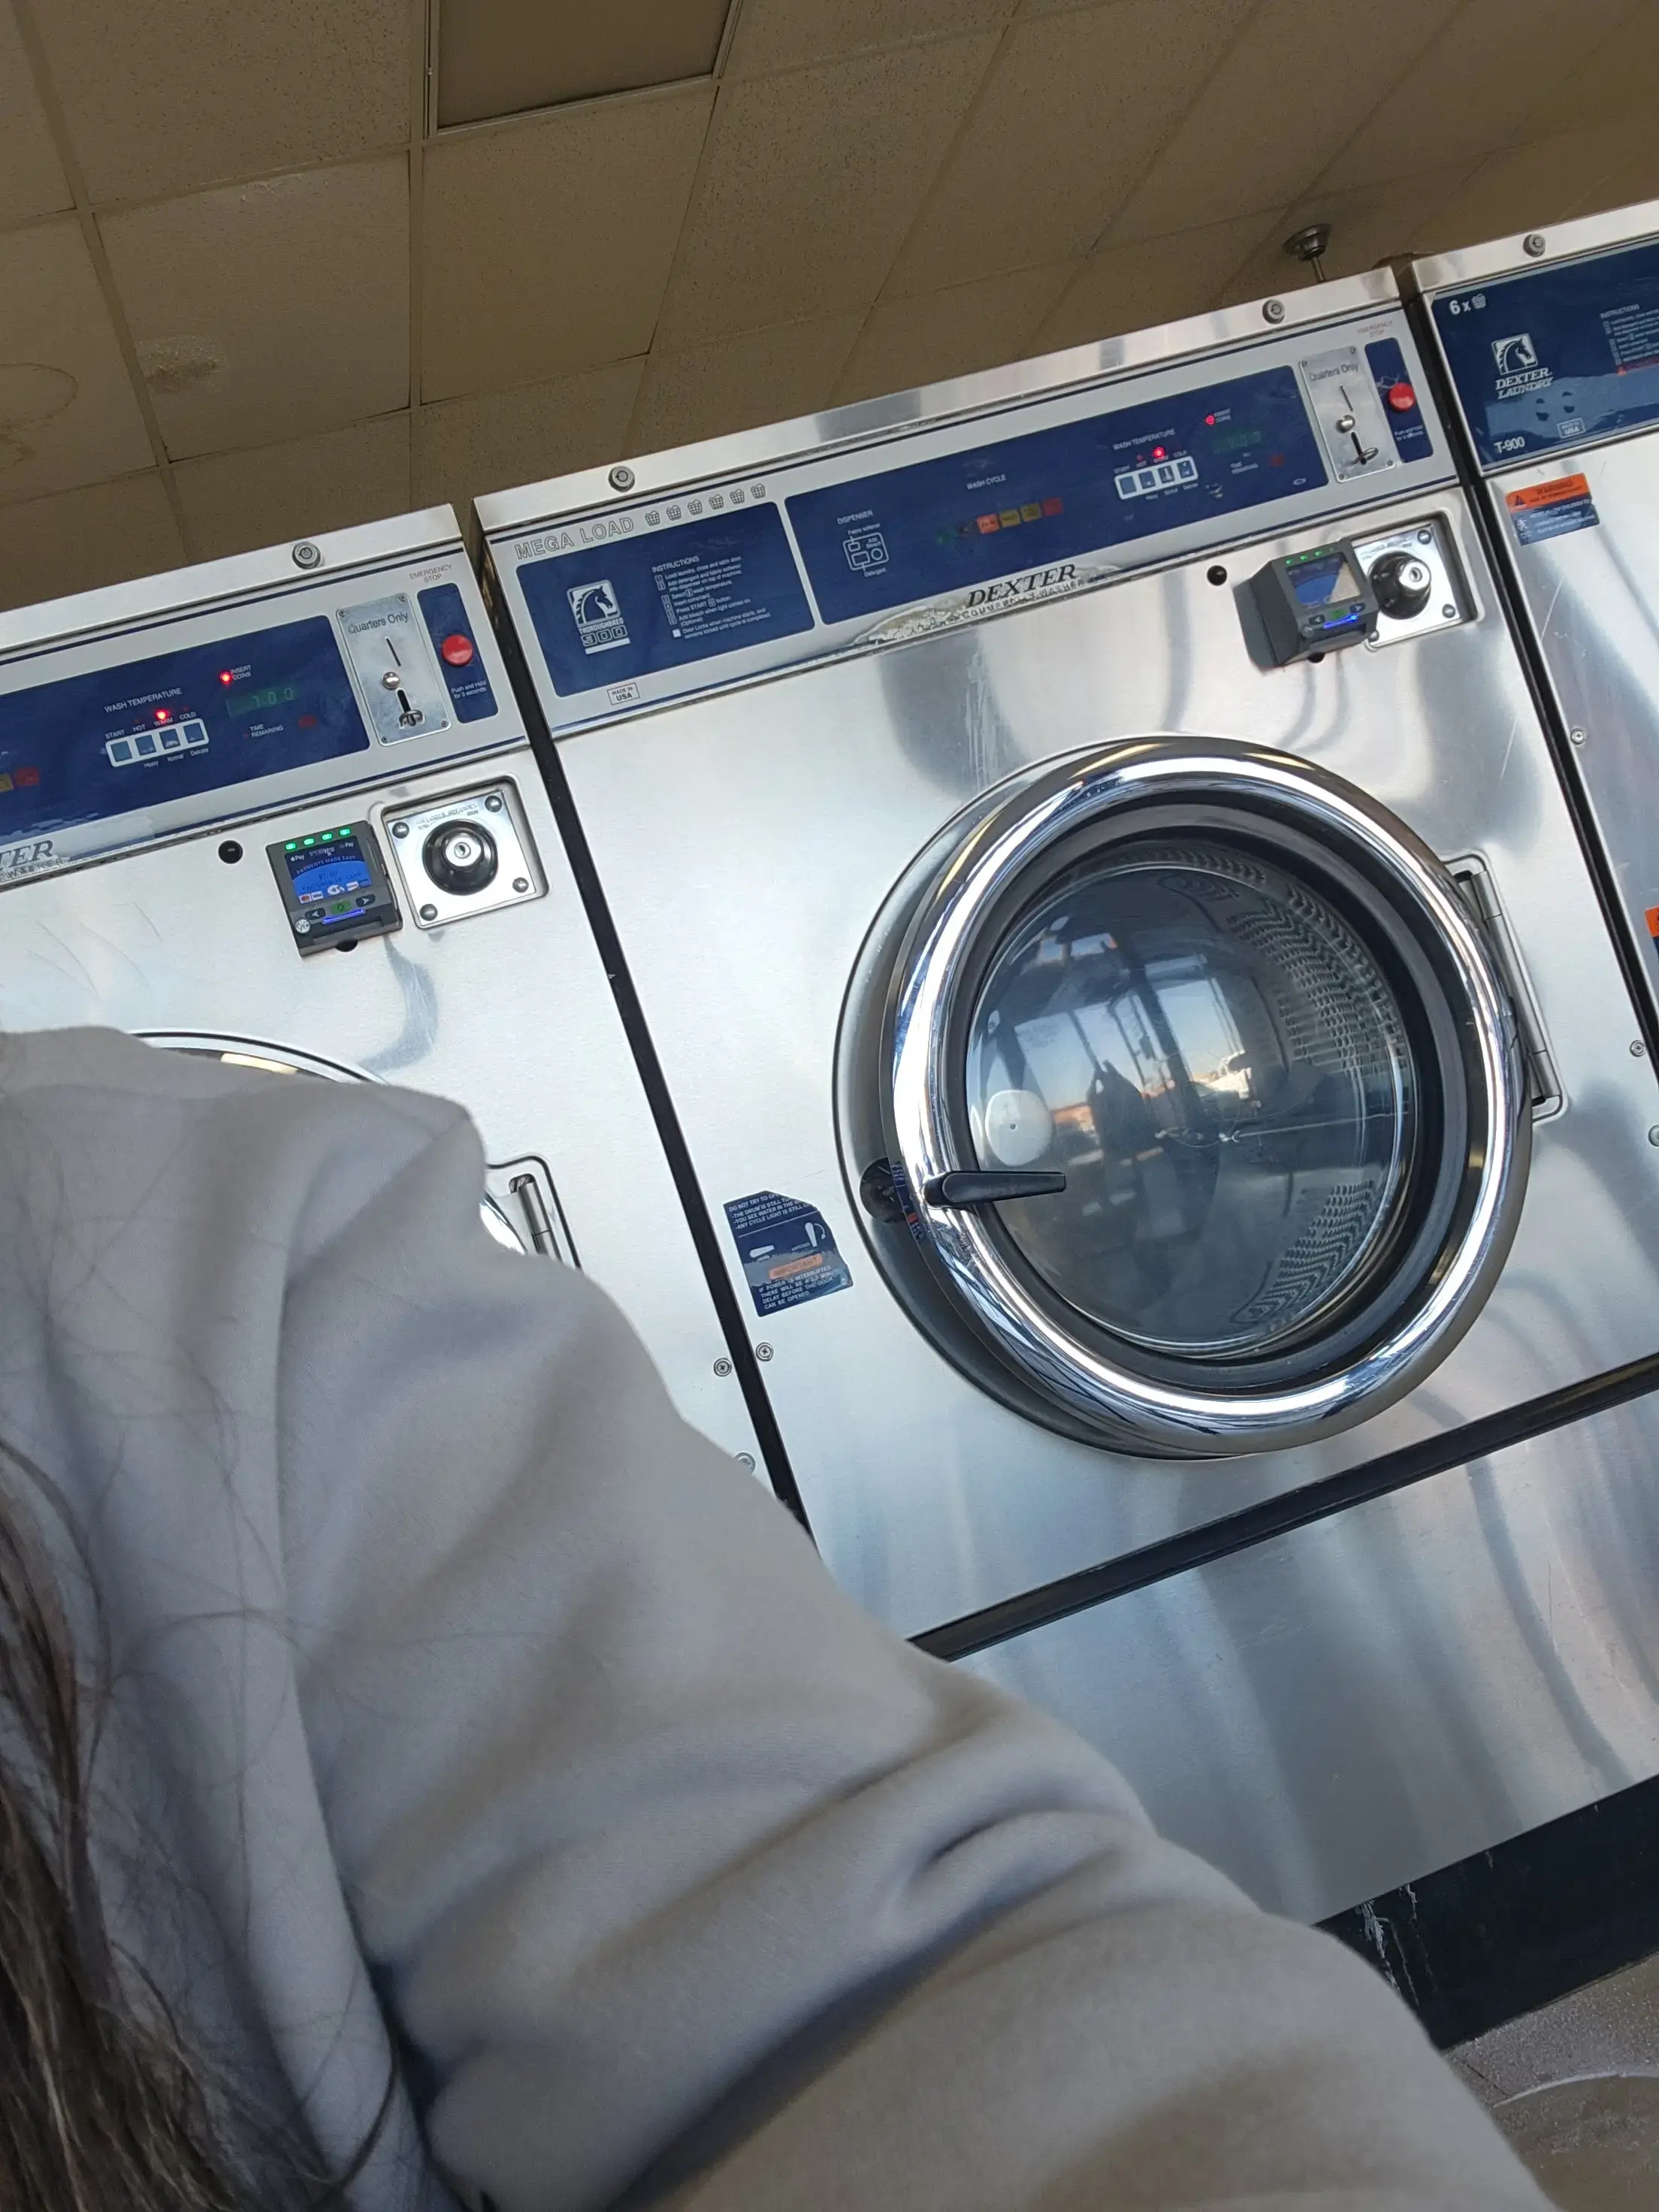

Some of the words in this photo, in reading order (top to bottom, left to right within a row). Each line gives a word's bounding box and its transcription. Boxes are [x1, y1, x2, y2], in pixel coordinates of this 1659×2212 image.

[1449, 301, 1461, 314] 6
[1309, 366, 1341, 382] Quarters
[1341, 362, 1358, 373] Only
[1495, 367, 1551, 390] DEXTER
[1497, 376, 1554, 400] LAUNDRY
[1494, 436, 1525, 454] T-900
[966, 479, 986, 490] WASH
[986, 473, 1007, 486] CYCLE
[515, 533, 574, 560] MEGA
[579, 517, 634, 543] LOAD
[409, 564, 452, 580] EMERGENCY
[652, 556, 699, 573] INSTRUCTIONS
[424, 573, 443, 583] STOP
[965, 564, 1077, 609] DEXTER
[348, 617, 386, 634] Quarters
[388, 612, 409, 624] Only
[579, 618, 624, 635] THOROUGHBRED
[582, 624, 627, 647] 900
[104, 700, 127, 714] WASH
[127, 687, 183, 708] TEMPERATURE
[616, 692, 633, 703] USA
[180, 712, 197, 721] COLD
[105, 729, 125, 740] START
[132, 724, 147, 733] HOT
[749, 1216, 766, 1225] CYCLE
[766, 1281, 786, 1289] POWER
[781, 1288, 802, 1297] BEFORE
[787, 1292, 809, 1301] OPENED
